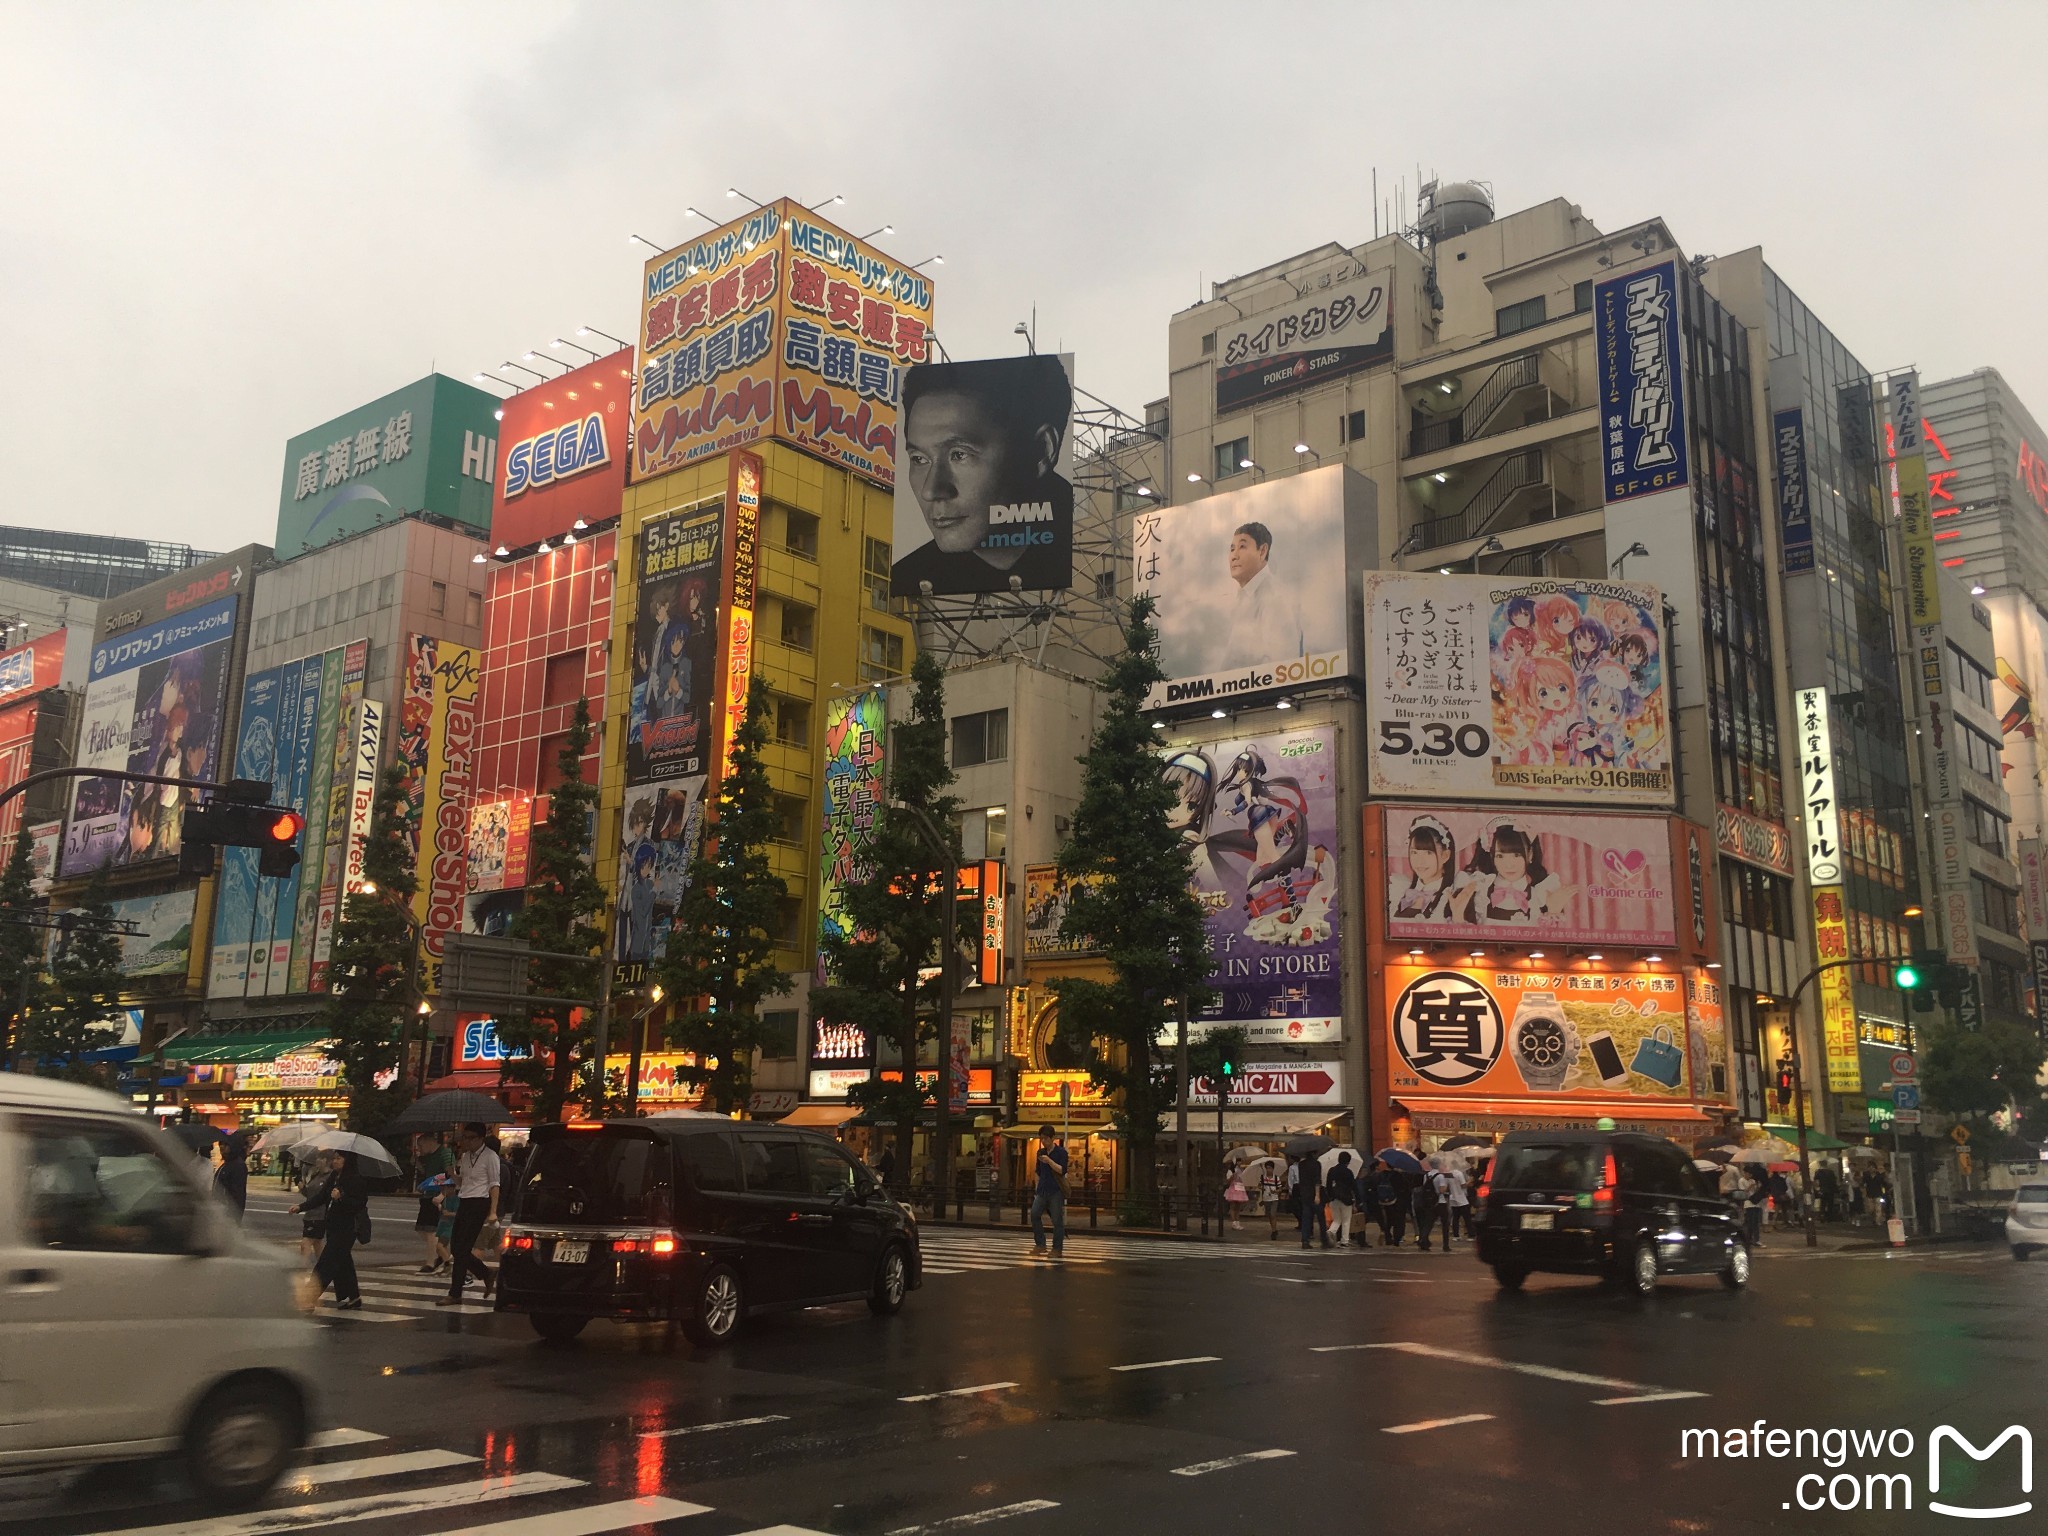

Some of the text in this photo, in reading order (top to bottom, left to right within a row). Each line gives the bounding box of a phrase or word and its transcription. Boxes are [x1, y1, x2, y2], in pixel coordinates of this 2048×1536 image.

[647, 207, 779, 301] MEDIAリサイクル
[789, 216, 931, 311] MEDIAリサイクル
[646, 250, 777, 351] 激安販売
[789, 256, 928, 363] 激安販売
[1225, 286, 1383, 365] メイドカジノ
[640, 307, 772, 410] 高額買取
[1604, 299, 1620, 396] トレーディングカードゲーム
[1263, 352, 1340, 385] POKER STARS
[637, 377, 773, 472] Mulan
[782, 377, 897, 467] Mula
[294, 410, 413, 501] 廣瀬無線
[504, 411, 612, 499] SEGA
[647, 451, 687, 475] ムーラン
[687, 442, 716, 460] AKIBA
[796, 430, 873, 472] ムーラン AKIBA
[1608, 414, 1625, 477] 秋葉原店
[737, 518, 756, 533] ブルーレイ
[738, 507, 756, 521] DVD
[989, 500, 1054, 525] DMM
[1903, 492, 1920, 535] Yellow
[736, 530, 755, 544] ゲーム
[738, 542, 752, 553] CD
[735, 552, 754, 565] アイドル
[735, 562, 754, 575] アニメ
[735, 574, 752, 586] コミック
[735, 584, 752, 597] ホビー
[1908, 545, 1929, 618] Submarine
[104, 609, 142, 633] Sofmap
[1420, 603, 1441, 670] うさぎ
[1919, 627, 1935, 636] 5F
[110, 630, 165, 665] ソフマップ
[1393, 606, 1418, 688] ですか?
[1443, 605, 1465, 691] ご注文は
[1275, 654, 1341, 683] solar
[1394, 708, 1437, 721] Blu-ray
[1445, 710, 1470, 720] DVD
[1420, 695, 1439, 707] My
[88, 719, 117, 754] Fate
[358, 703, 380, 770] AKKY
[1379, 721, 1490, 758] 5.30
[653, 761, 686, 775] ヴァンガード
[1498, 770, 1529, 784] DMS
[1802, 690, 1836, 860] 喫茶室 ルノアール
[851, 729, 876, 882] 日本最大級
[828, 773, 851, 911] 電子タバコ
[1716, 809, 1794, 872] メイドカジノ
[1940, 811, 1960, 880] amiami
[1587, 885, 1664, 900] @home cafe
[984, 893, 997, 950] 吉野家
[1815, 891, 1847, 958] 免税
[1227, 953, 1331, 977] IN STORE
[1496, 975, 1676, 992] 時計 バッグ 貴金属 ダイヤ 携帯
[1250, 1027, 1264, 1035] and
[1265, 1027, 1284, 1036] more
[1406, 988, 1495, 1073] 質
[1841, 1007, 1856, 1057] FREE
[293, 1056, 318, 1077] Shop
[1255, 1062, 1282, 1071] Magazine
[1288, 1062, 1323, 1070] MANGA-ZIN
[1268, 1073, 1298, 1093] ZIN
[1895, 1060, 1910, 1071] 40
[752, 1093, 792, 1110] ラーメン
[1194, 1095, 1252, 1105] Akihbara
[1898, 1091, 1909, 1104] P
[560, 1250, 587, 1262] 43-07
